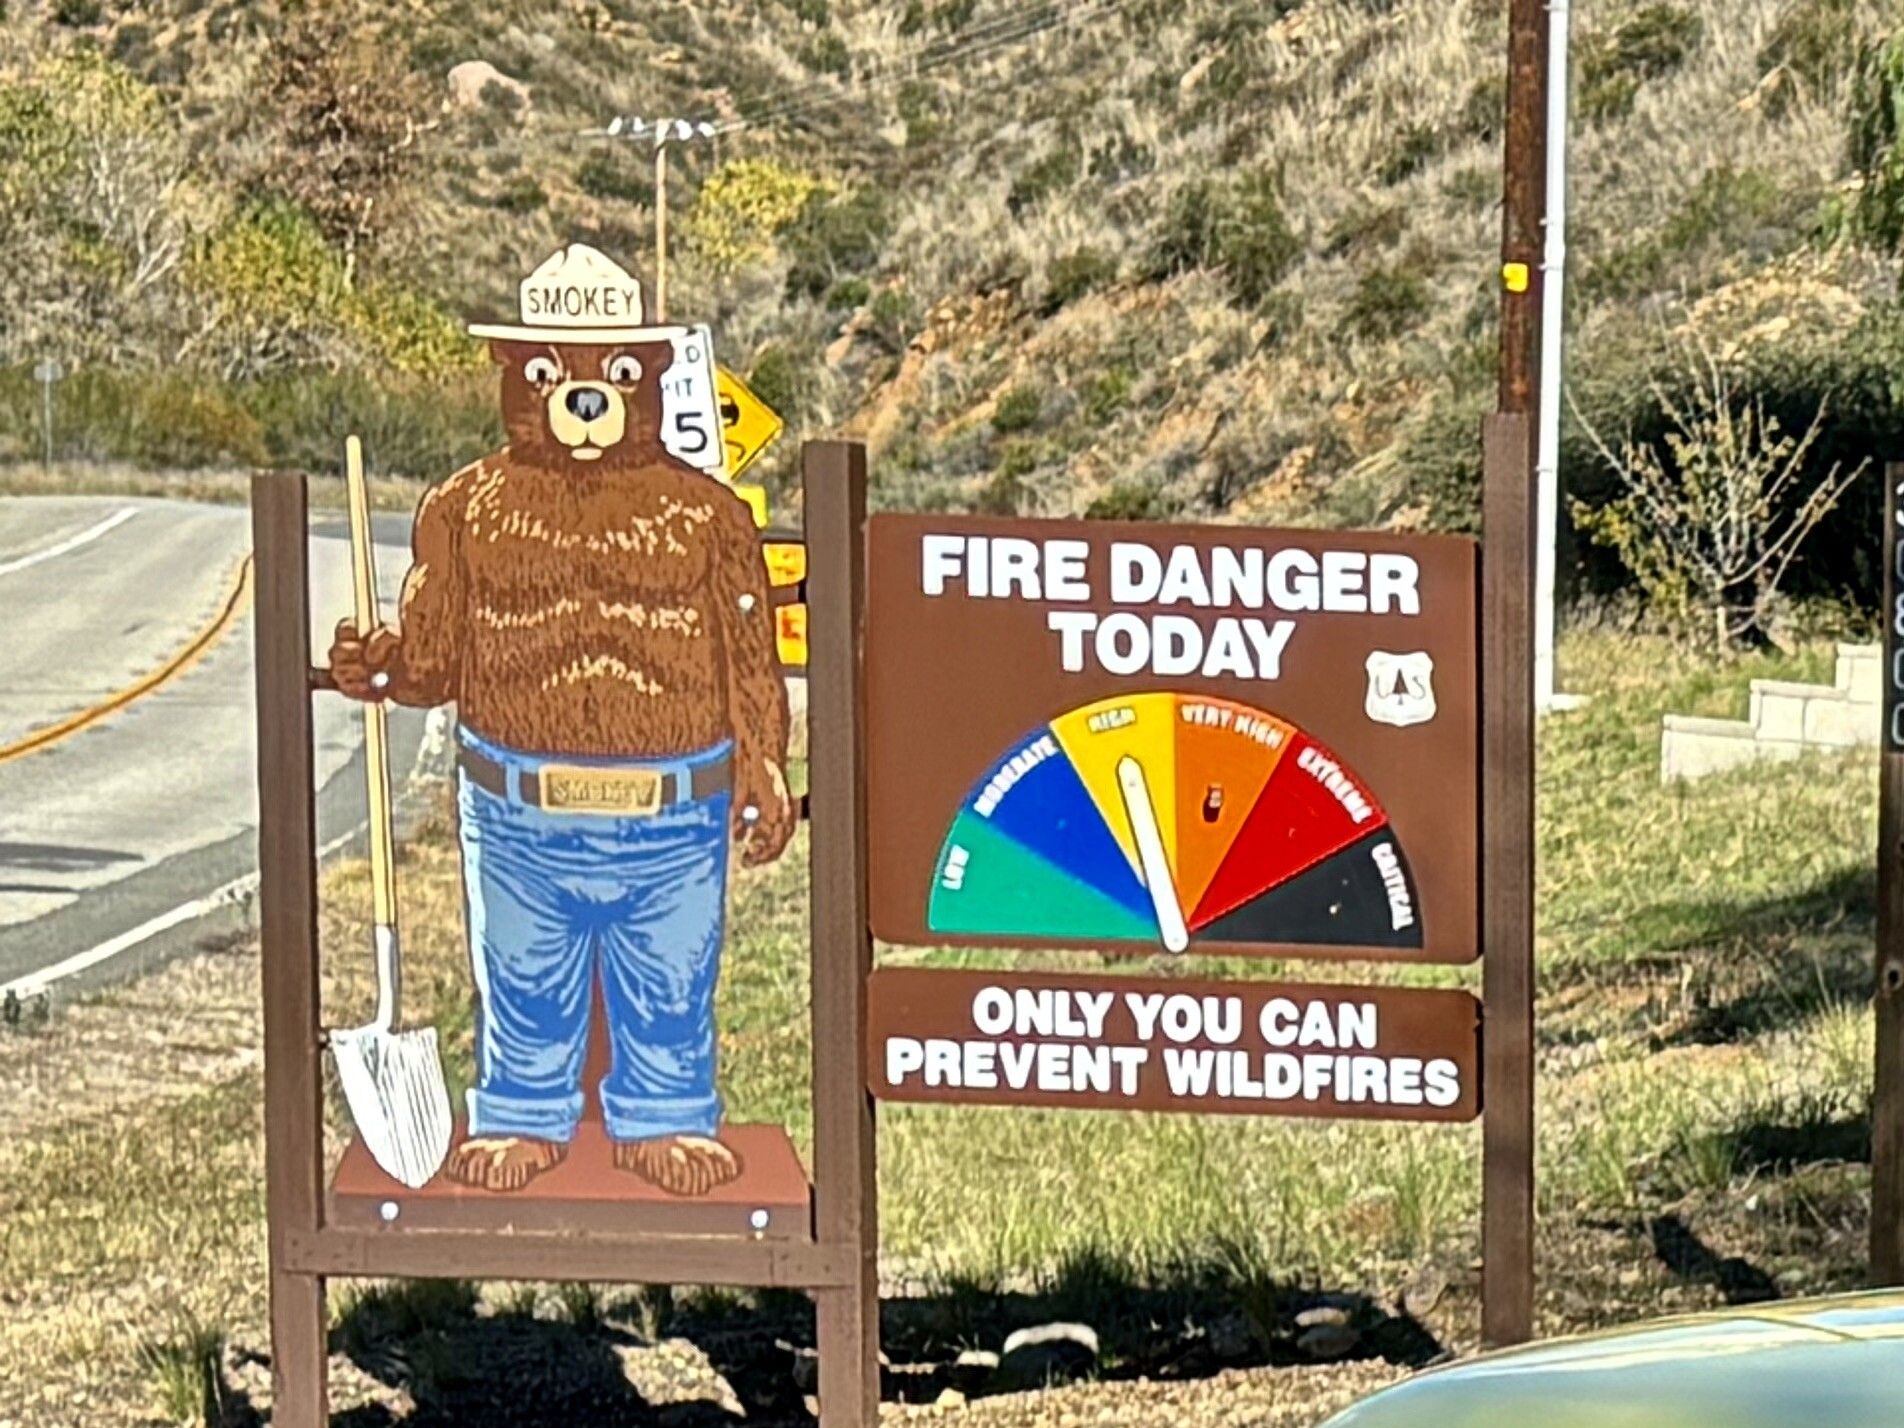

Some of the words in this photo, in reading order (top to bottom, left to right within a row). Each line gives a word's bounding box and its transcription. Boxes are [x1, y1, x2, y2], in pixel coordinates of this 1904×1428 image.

[528, 286, 635, 316] SMOKEY
[675, 411, 708, 453] 5
[923, 535, 1090, 600] FIRE
[1111, 543, 1420, 614] DANGER
[1048, 611, 1296, 679] TODAY
[1088, 707, 1136, 733] HIGH
[1181, 704, 1233, 728] VERY
[1235, 714, 1284, 750] HIGH
[1297, 747, 1373, 824] EXTREME
[942, 844, 969, 890] LOW
[973, 987, 1114, 1038] ONLY
[1125, 993, 1242, 1044] YOU
[1259, 998, 1376, 1049] CAN
[887, 1038, 1148, 1095] PREVENT
[1163, 1048, 1459, 1106] WILDFIRES
